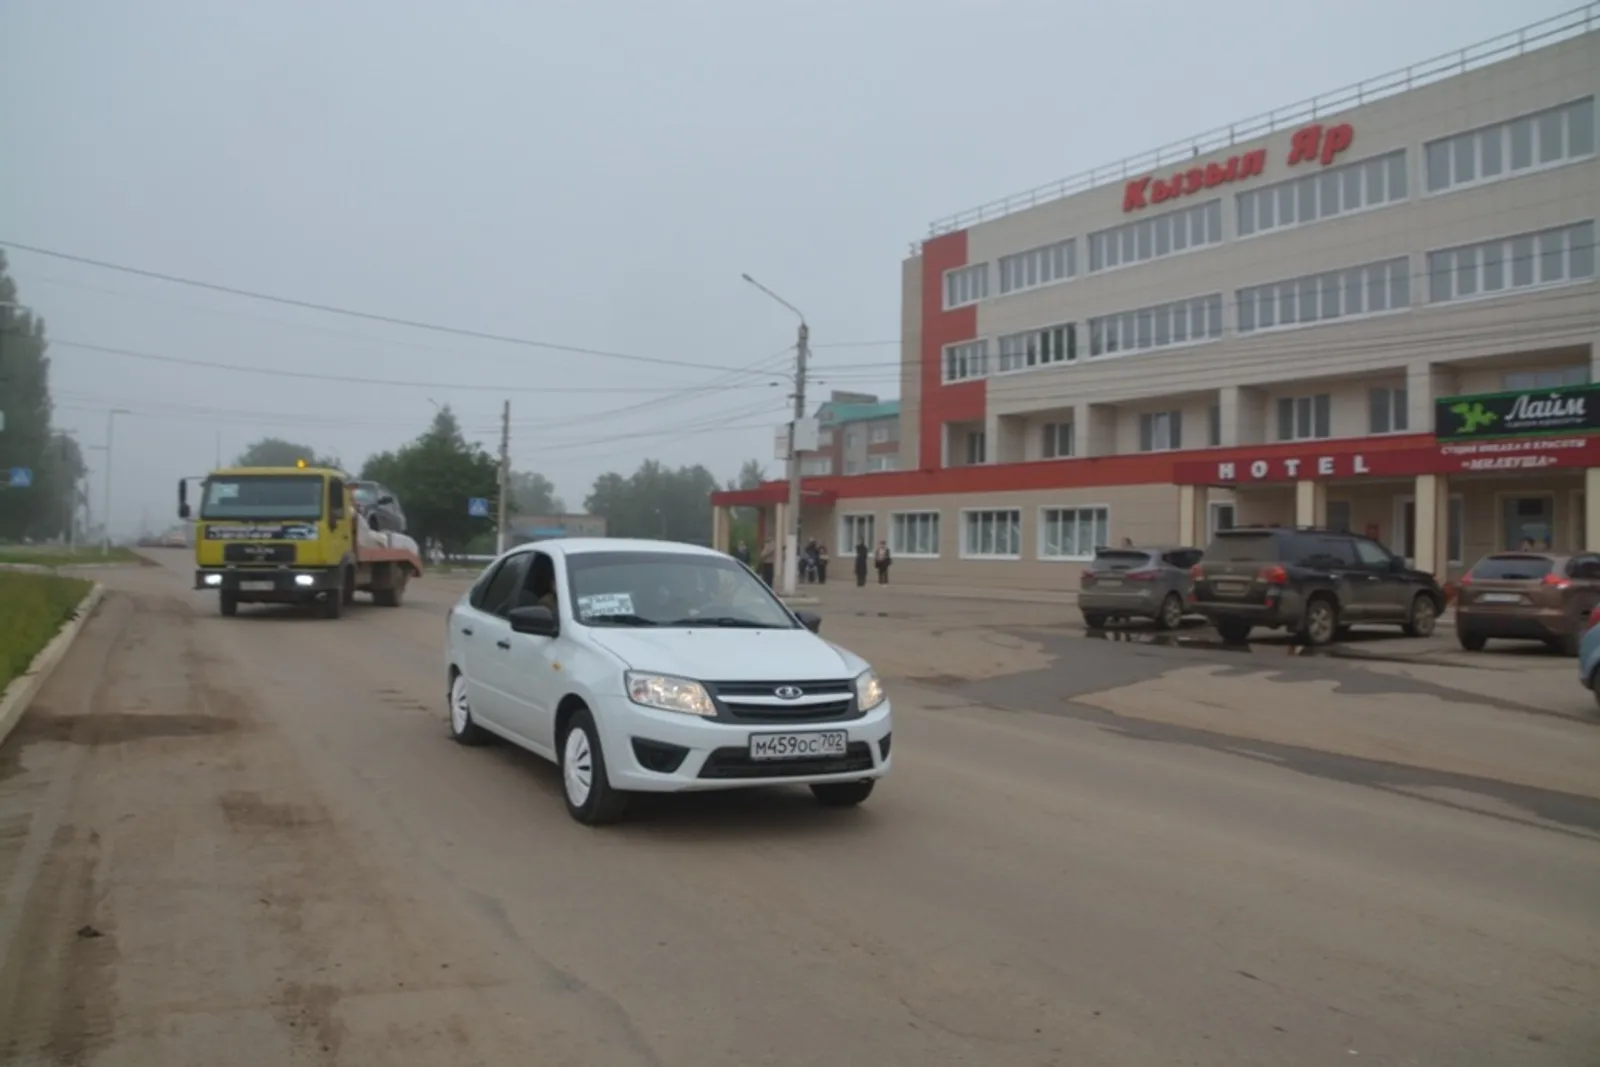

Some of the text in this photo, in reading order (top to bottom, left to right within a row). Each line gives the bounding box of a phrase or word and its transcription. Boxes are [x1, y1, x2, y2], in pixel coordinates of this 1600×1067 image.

[1122, 122, 1354, 213] Кызыл Яр
[1504, 393, 1587, 421] Лайм
[1218, 454, 1370, 480] HOTEL
